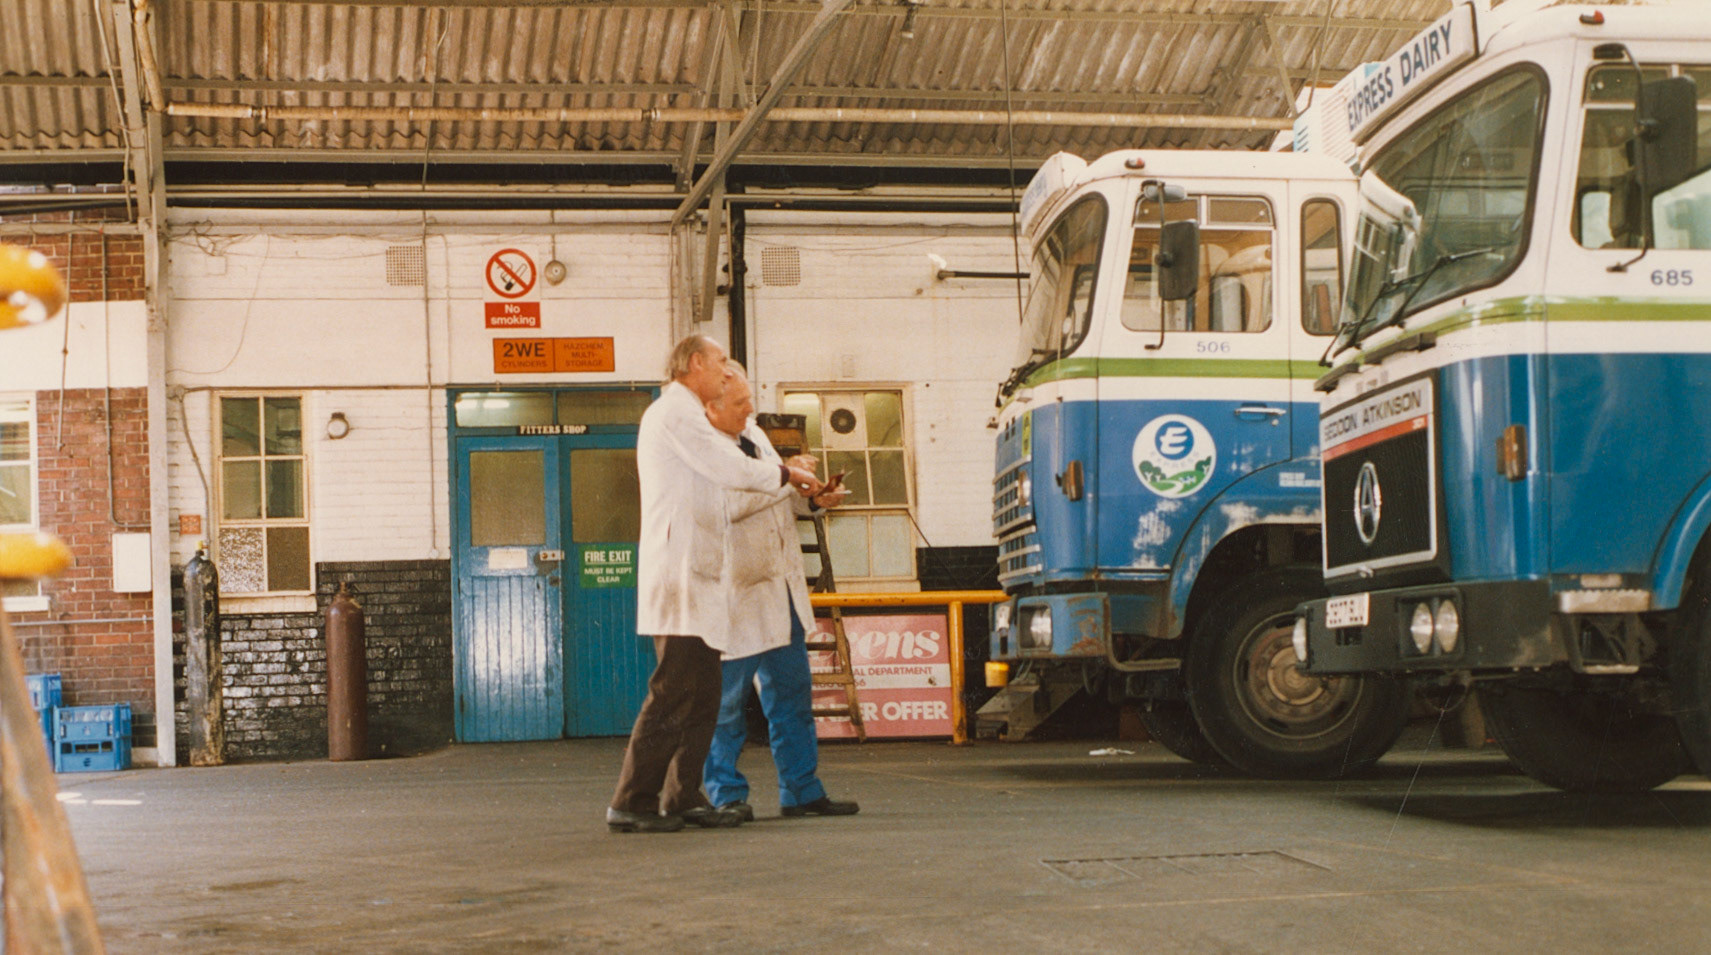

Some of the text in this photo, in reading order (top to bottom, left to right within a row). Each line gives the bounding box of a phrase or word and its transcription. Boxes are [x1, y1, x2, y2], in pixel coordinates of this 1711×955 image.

[1347, 19, 1453, 132] EXPRESS DAIRY
[1650, 269, 1693, 286] 685
[504, 303, 521, 314] No
[490, 315, 536, 326] smoking
[503, 342, 545, 358] 2WE
[563, 342, 604, 351] HAZCHEM
[1197, 341, 1230, 353] 506
[501, 360, 548, 368] CYLINDERS
[565, 359, 602, 367] STORAGE
[1362, 389, 1422, 427] ATKINSON
[520, 425, 587, 434] FITTERS SHOP
[584, 550, 632, 562] FIRE EXIT
[584, 567, 603, 575] MUST
[867, 666, 933, 676] DEPARTMENT
[882, 700, 949, 721] OFFER
